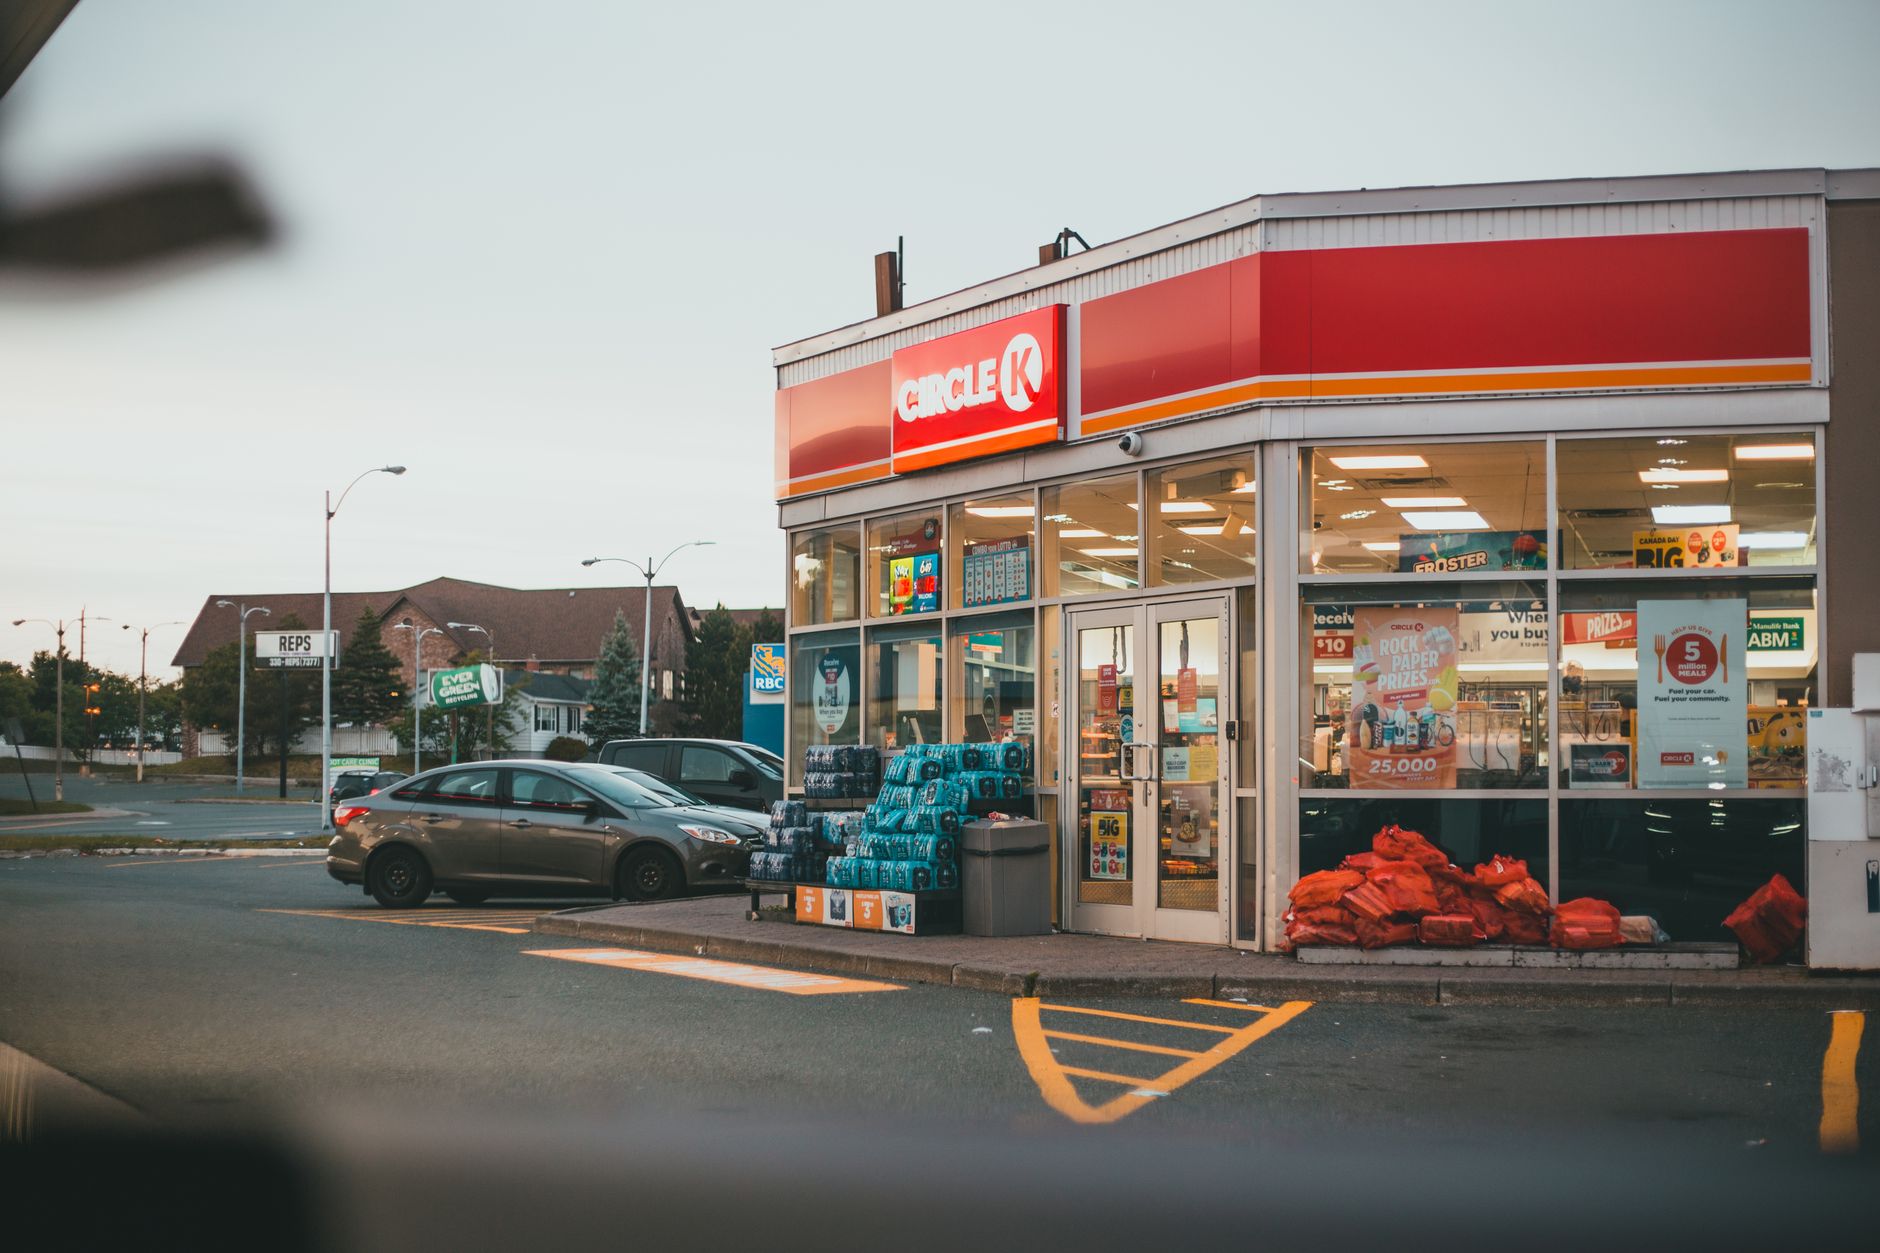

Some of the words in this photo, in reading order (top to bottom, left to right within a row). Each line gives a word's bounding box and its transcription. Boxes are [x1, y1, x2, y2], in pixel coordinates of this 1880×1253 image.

[898, 357, 997, 423] CIRCLE
[1003, 335, 1042, 411] K
[1640, 537, 1666, 545] CANADA
[1414, 551, 1488, 573] FROSTER
[1636, 547, 1684, 569] BIG
[1414, 622, 1424, 632] K
[279, 635, 311, 652] REPS
[1491, 630, 1519, 642] you
[1748, 632, 1789, 647] ABM
[1317, 638, 1346, 653] $10
[1380, 635, 1418, 656] ROCK
[1684, 640, 1700, 661] 5
[1392, 650, 1439, 673] PAPER
[442, 671, 473, 686] EVER
[755, 677, 784, 689] RBC
[439, 681, 480, 697] GREEN
[446, 693, 478, 704] RECYCLING
[1689, 696, 1730, 704] community.
[1369, 757, 1437, 776] 25,000
[1098, 819, 1120, 837] BIG
